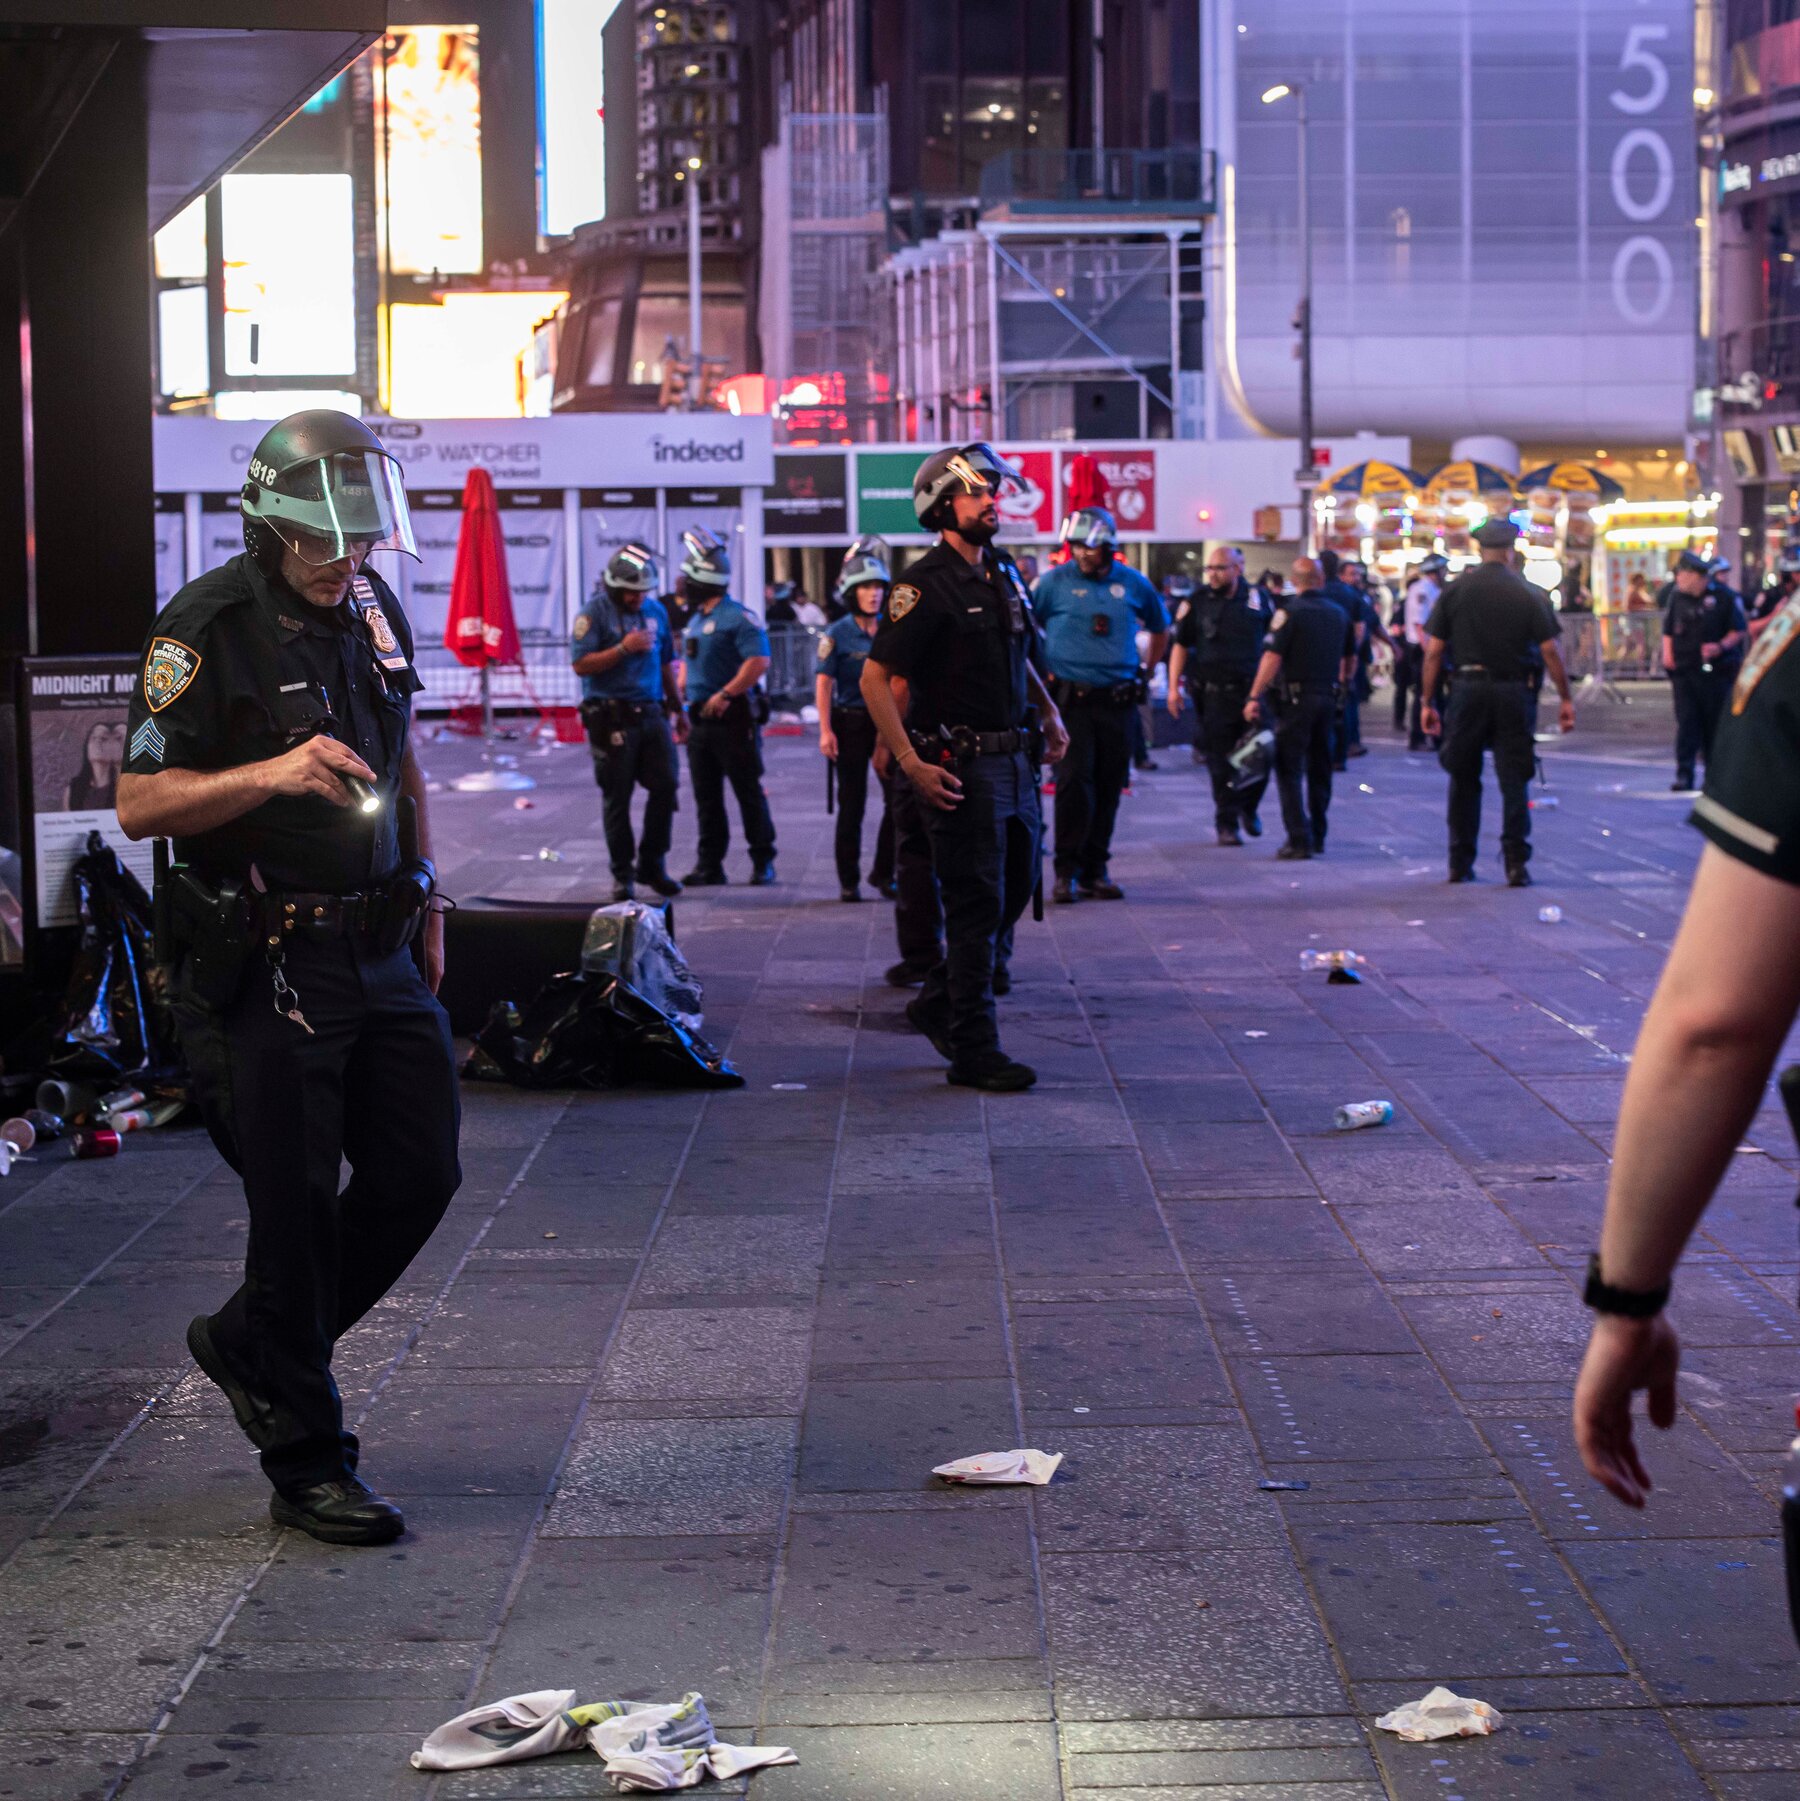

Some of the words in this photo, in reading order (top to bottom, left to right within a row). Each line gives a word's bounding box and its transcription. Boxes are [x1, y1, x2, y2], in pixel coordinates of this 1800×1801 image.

[1610, 0, 1674, 327] 500
[436, 442, 542, 463] WATCHER
[654, 437, 744, 462] indeed
[250, 457, 277, 486] 4818
[153, 649, 192, 672] DEPARTMENT
[163, 643, 187, 659] POLICE
[32, 674, 111, 695] MIDNIGHT
[114, 674, 138, 693] MO
[159, 692, 172, 704] NEW
[171, 675, 189, 693] YORK
